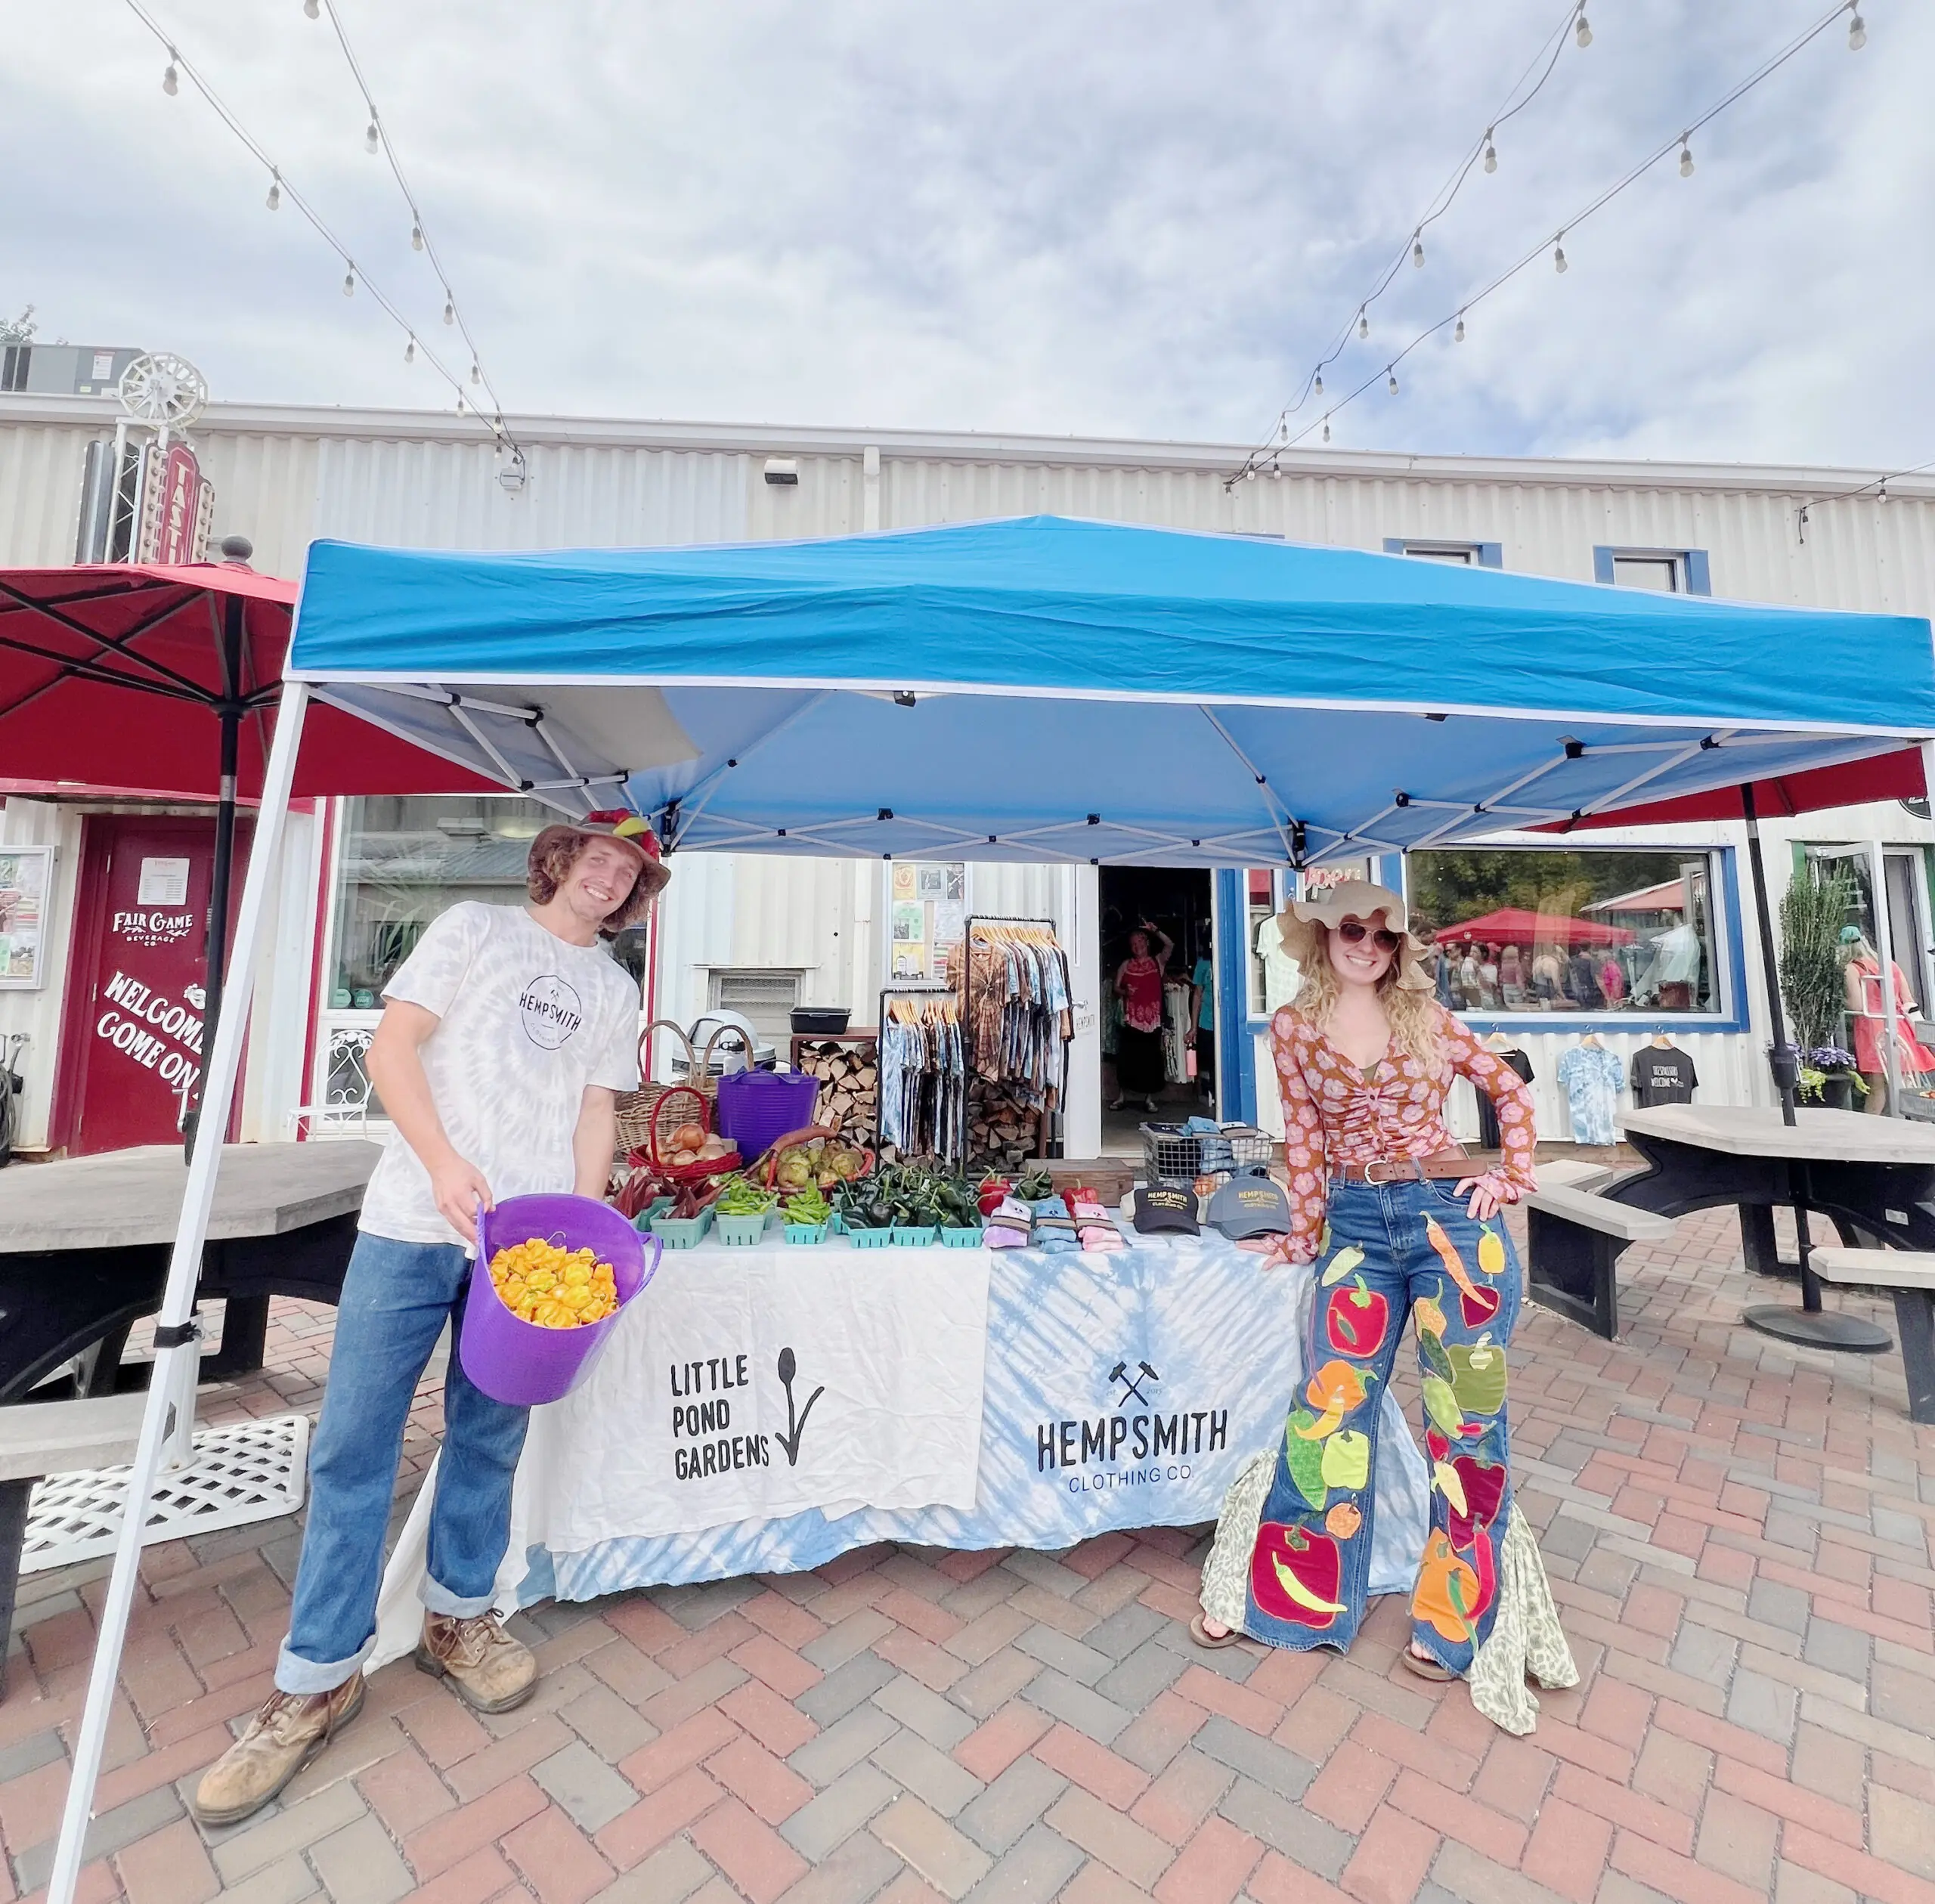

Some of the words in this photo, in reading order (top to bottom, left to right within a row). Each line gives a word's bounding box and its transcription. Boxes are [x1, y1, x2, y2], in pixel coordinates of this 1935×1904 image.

[112, 912, 147, 932] FAIR
[149, 912, 194, 932] GAME
[126, 934, 175, 943] BEVERAGE
[519, 992, 582, 1032] HEMPSMITH
[97, 1011, 167, 1069] COME
[159, 1052, 201, 1089] ON
[1147, 1191, 1187, 1203] HEMPSMITH
[671, 1354, 749, 1397] LITTLE
[673, 1399, 730, 1438] POND
[675, 1434, 769, 1480] GARDENS
[1038, 1409, 1228, 1472] HEMPSMITH
[1069, 1467, 1161, 1493] CLOTHING
